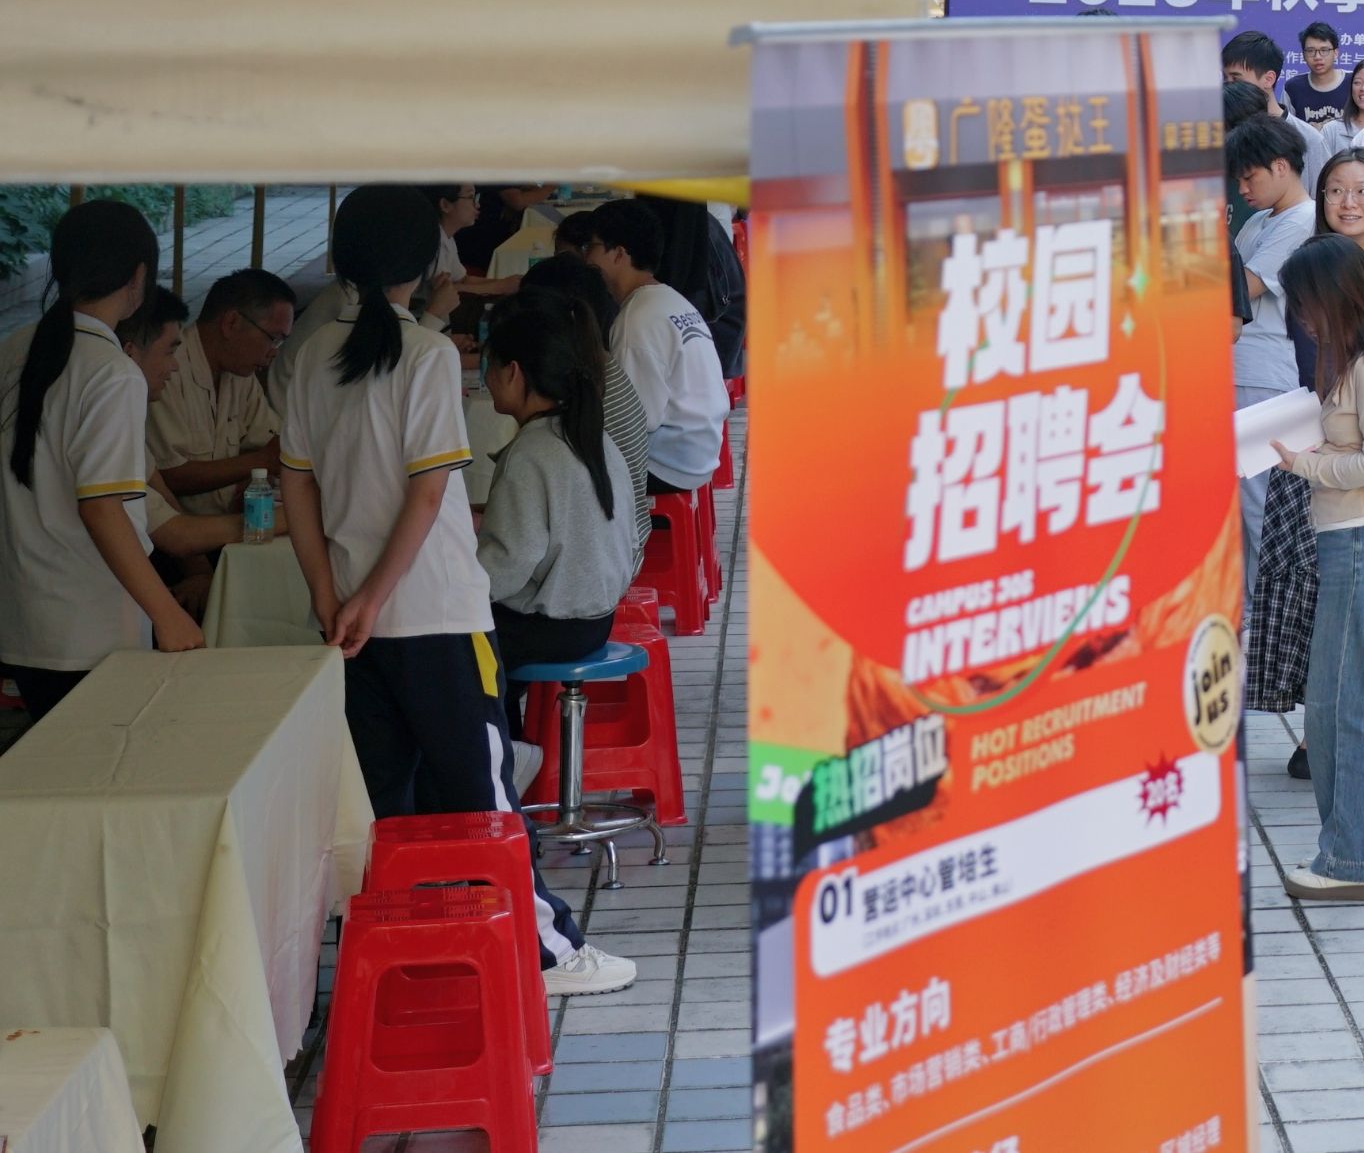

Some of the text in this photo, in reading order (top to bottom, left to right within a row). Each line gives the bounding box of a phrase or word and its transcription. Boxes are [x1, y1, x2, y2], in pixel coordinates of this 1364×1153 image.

[936, 218, 1113, 390] 校园
[903, 372, 1167, 572] 招聘会
[902, 574, 1132, 686] INTERVIEWS
[905, 579, 995, 627] CAMPUS
[970, 681, 1148, 762] HOT RECRUITMENT
[1192, 650, 1233, 727] join
[1206, 689, 1230, 724] us
[756, 763, 813, 804] Jo
[812, 713, 949, 836] 热招岗位
[970, 733, 1076, 792] POSITIONS
[818, 875, 855, 925] 01
[862, 842, 999, 924] 营运中心管培生
[823, 976, 952, 1072] 专业方向
